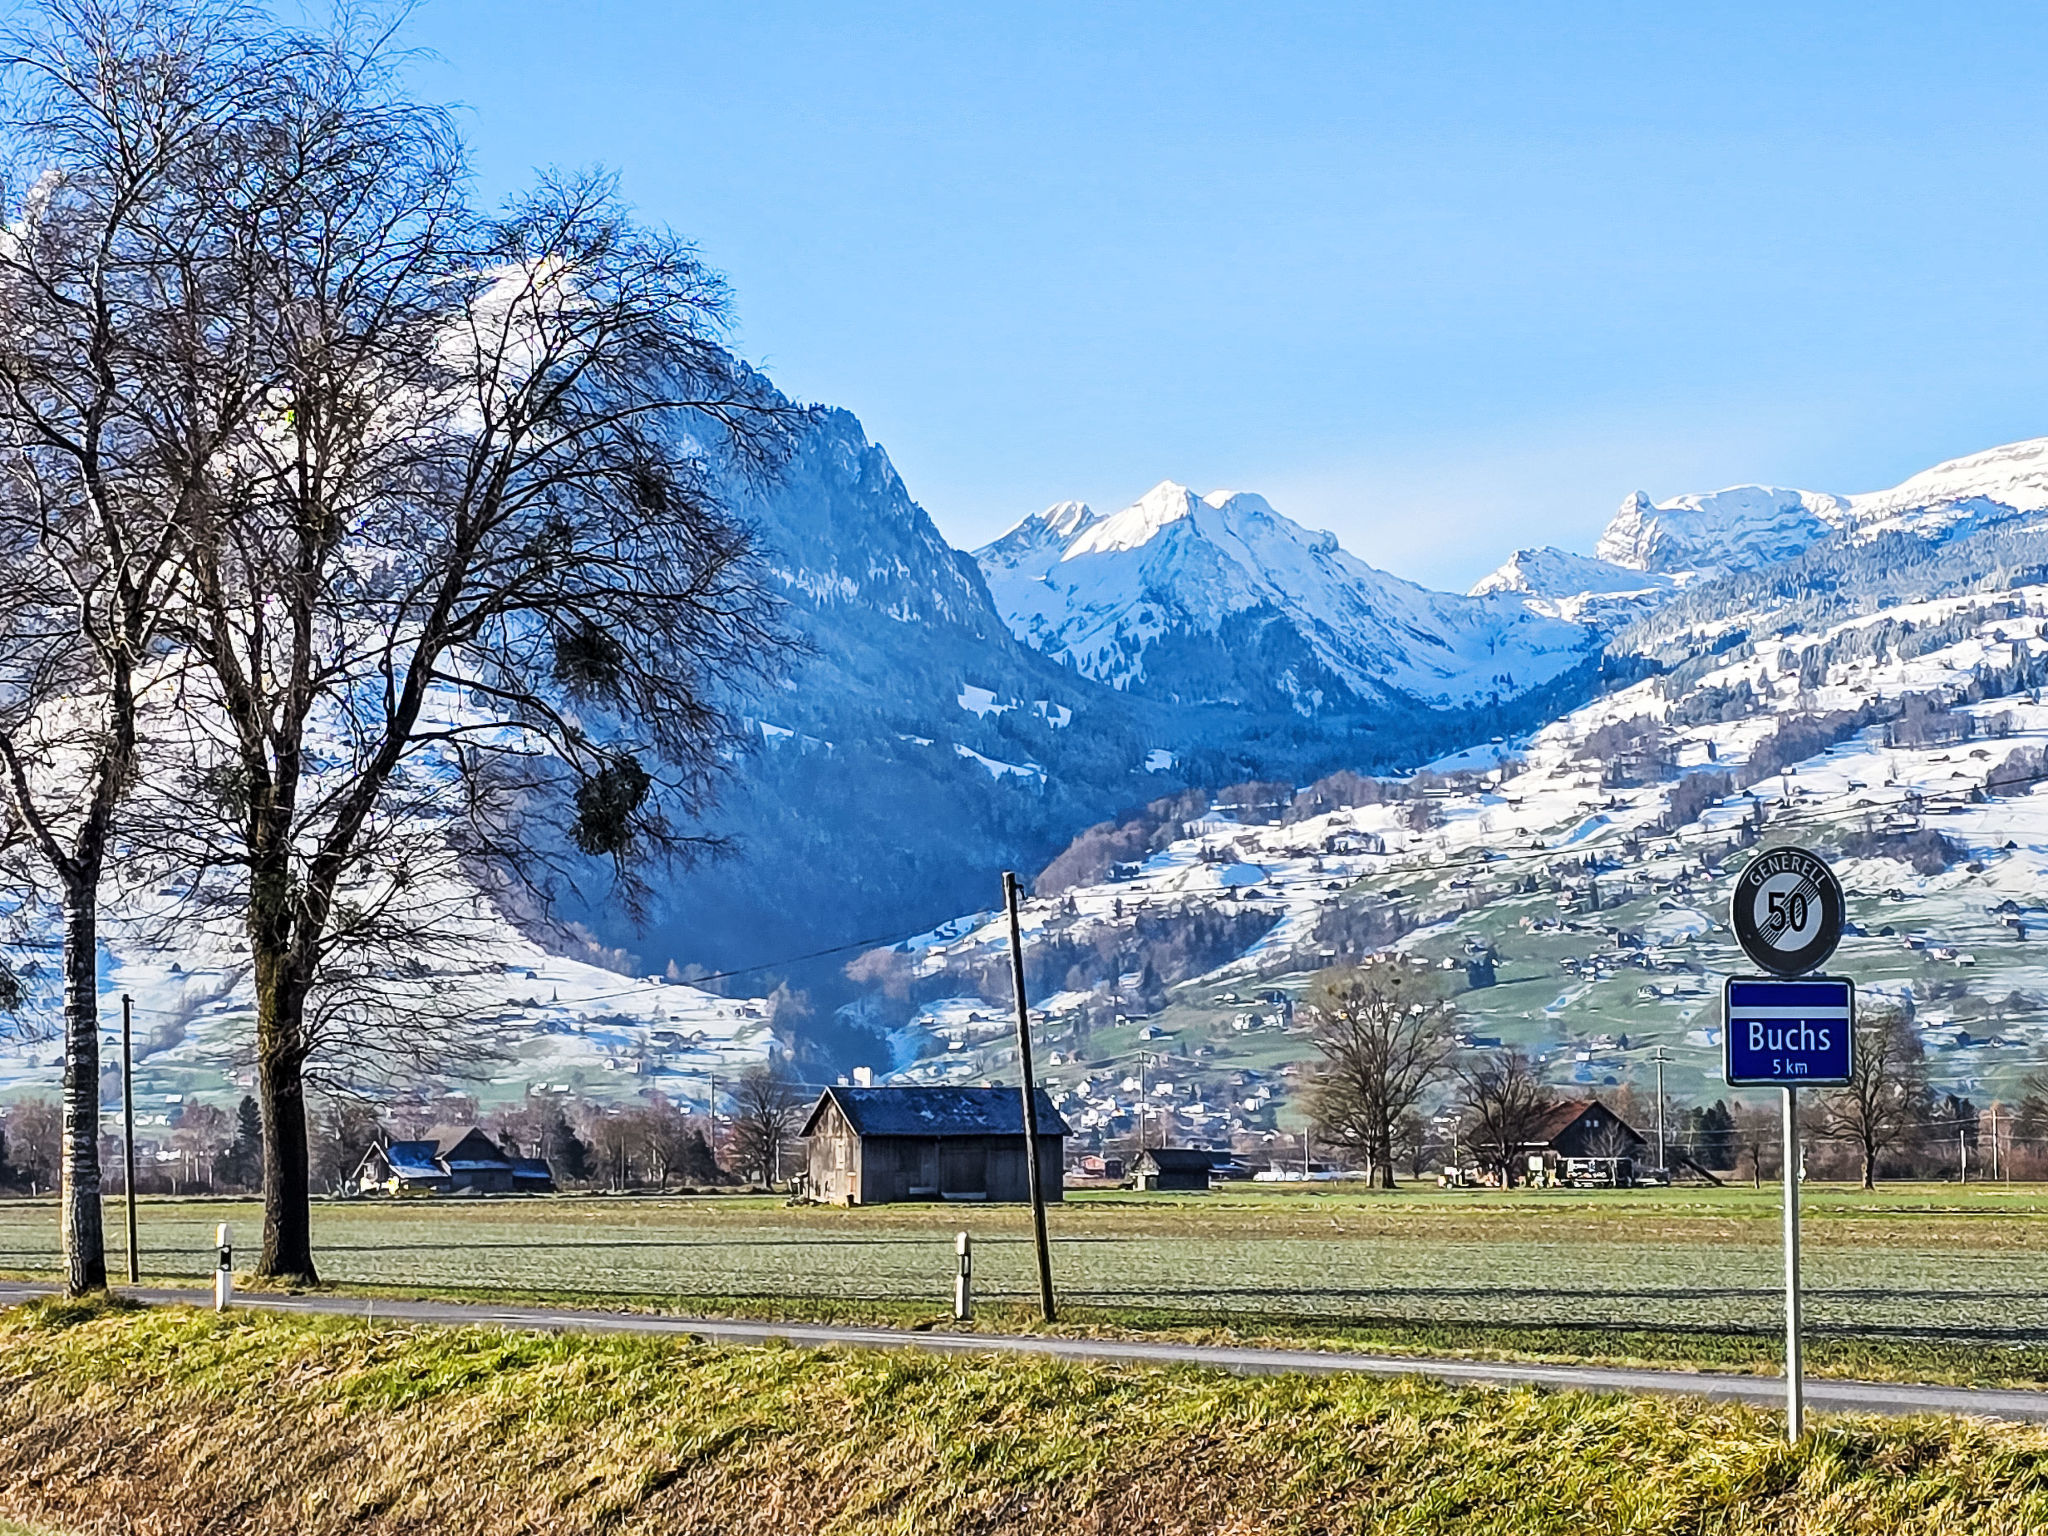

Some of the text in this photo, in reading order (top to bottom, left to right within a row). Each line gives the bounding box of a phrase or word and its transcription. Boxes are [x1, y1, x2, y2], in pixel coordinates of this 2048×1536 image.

[1750, 855, 1825, 888] GENERELL
[1768, 891, 1808, 932] 50
[1749, 1020, 1831, 1051] Buchs
[1773, 1058, 1808, 1074] 5 km
